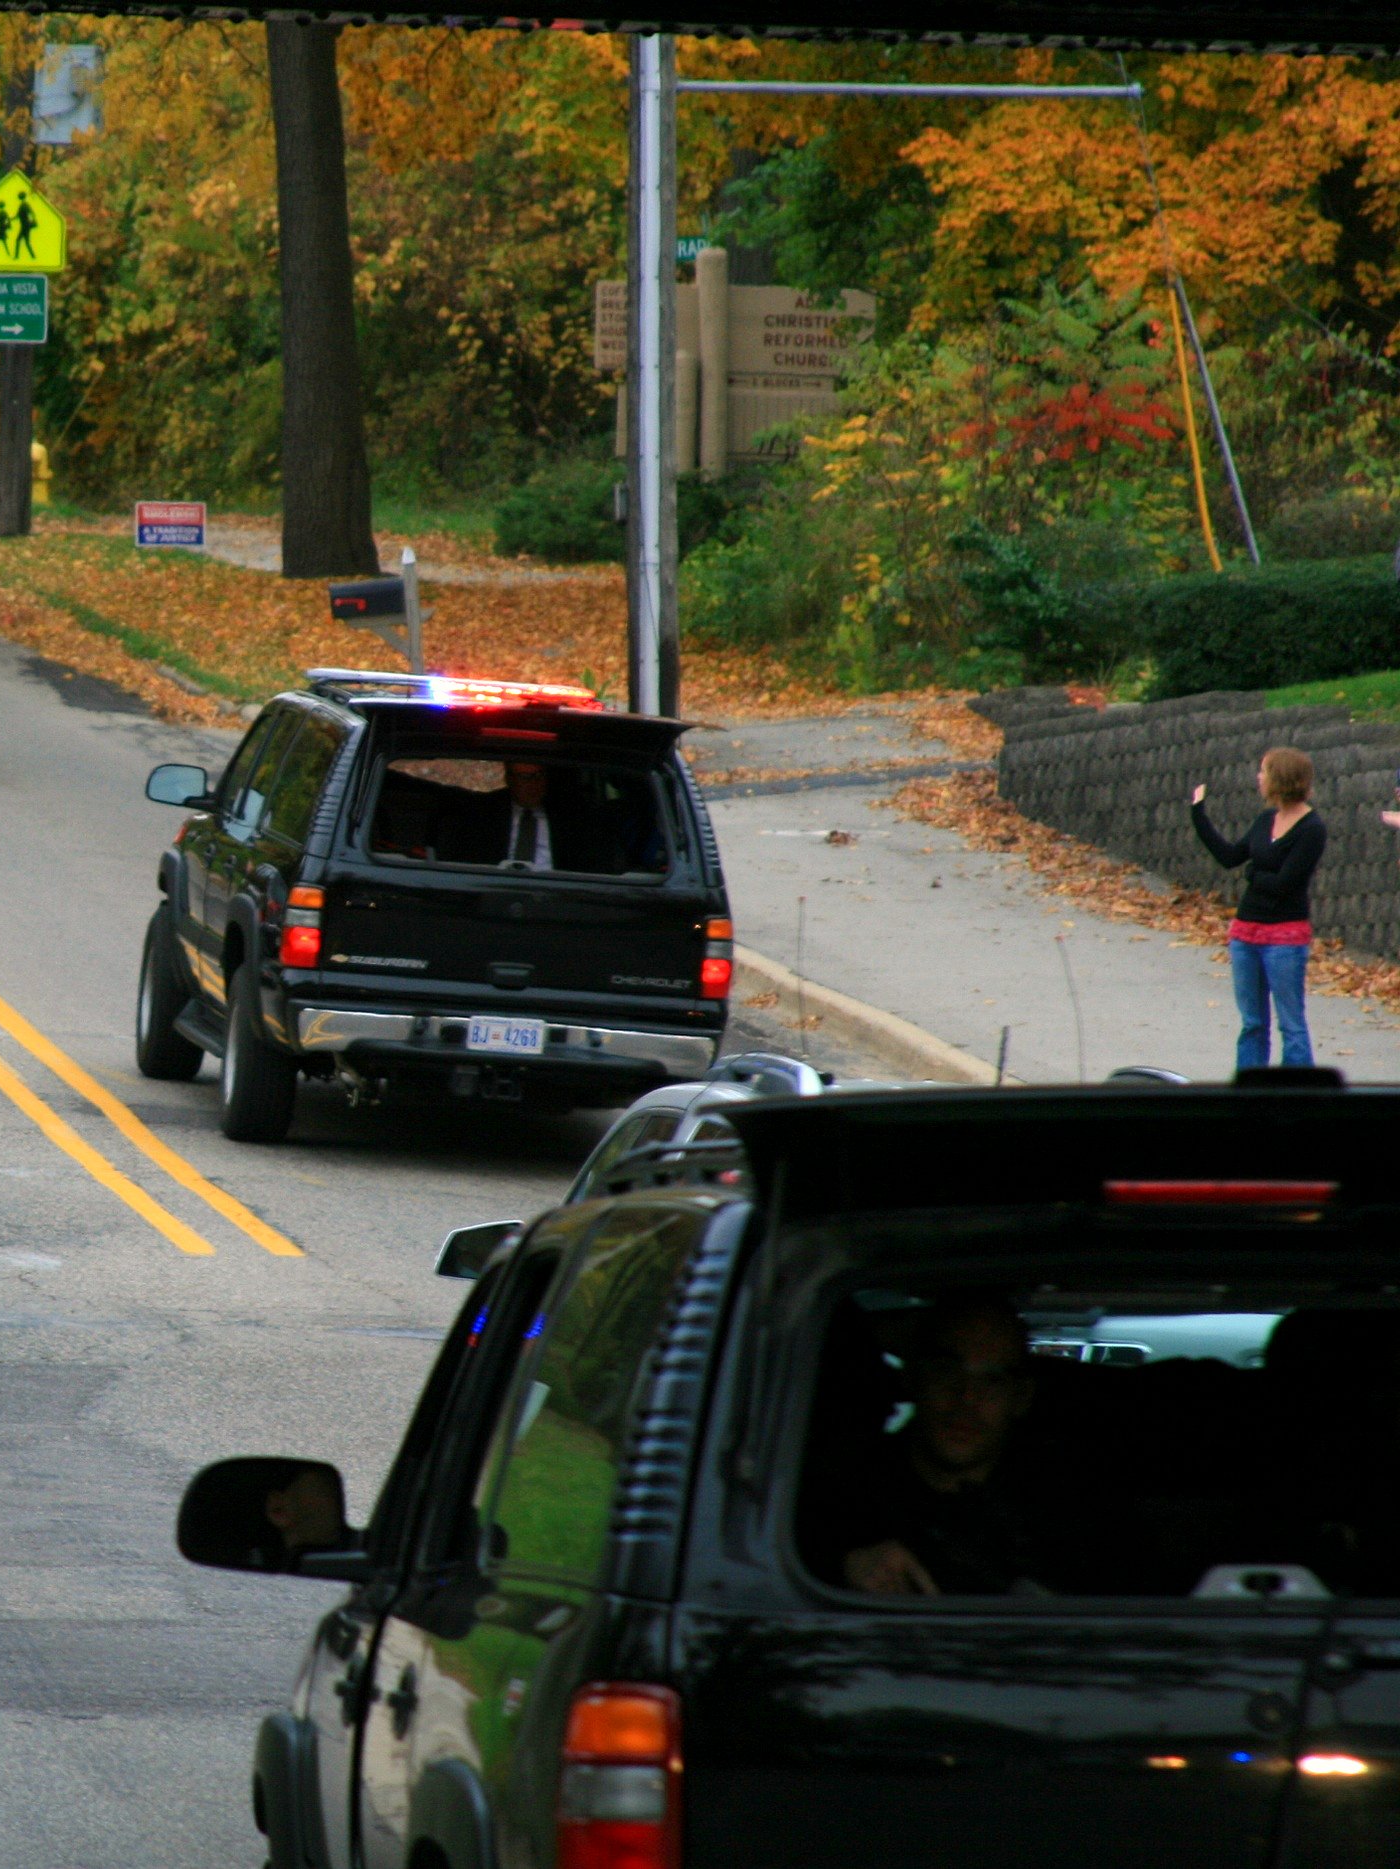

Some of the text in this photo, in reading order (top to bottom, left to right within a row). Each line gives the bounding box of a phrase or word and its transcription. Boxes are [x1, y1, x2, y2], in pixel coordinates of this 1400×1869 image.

[12, 282, 39, 295] VISTA
[9, 302, 45, 315] SCHOOL
[763, 313, 837, 328] CHRISTI
[773, 352, 831, 367] CHURC
